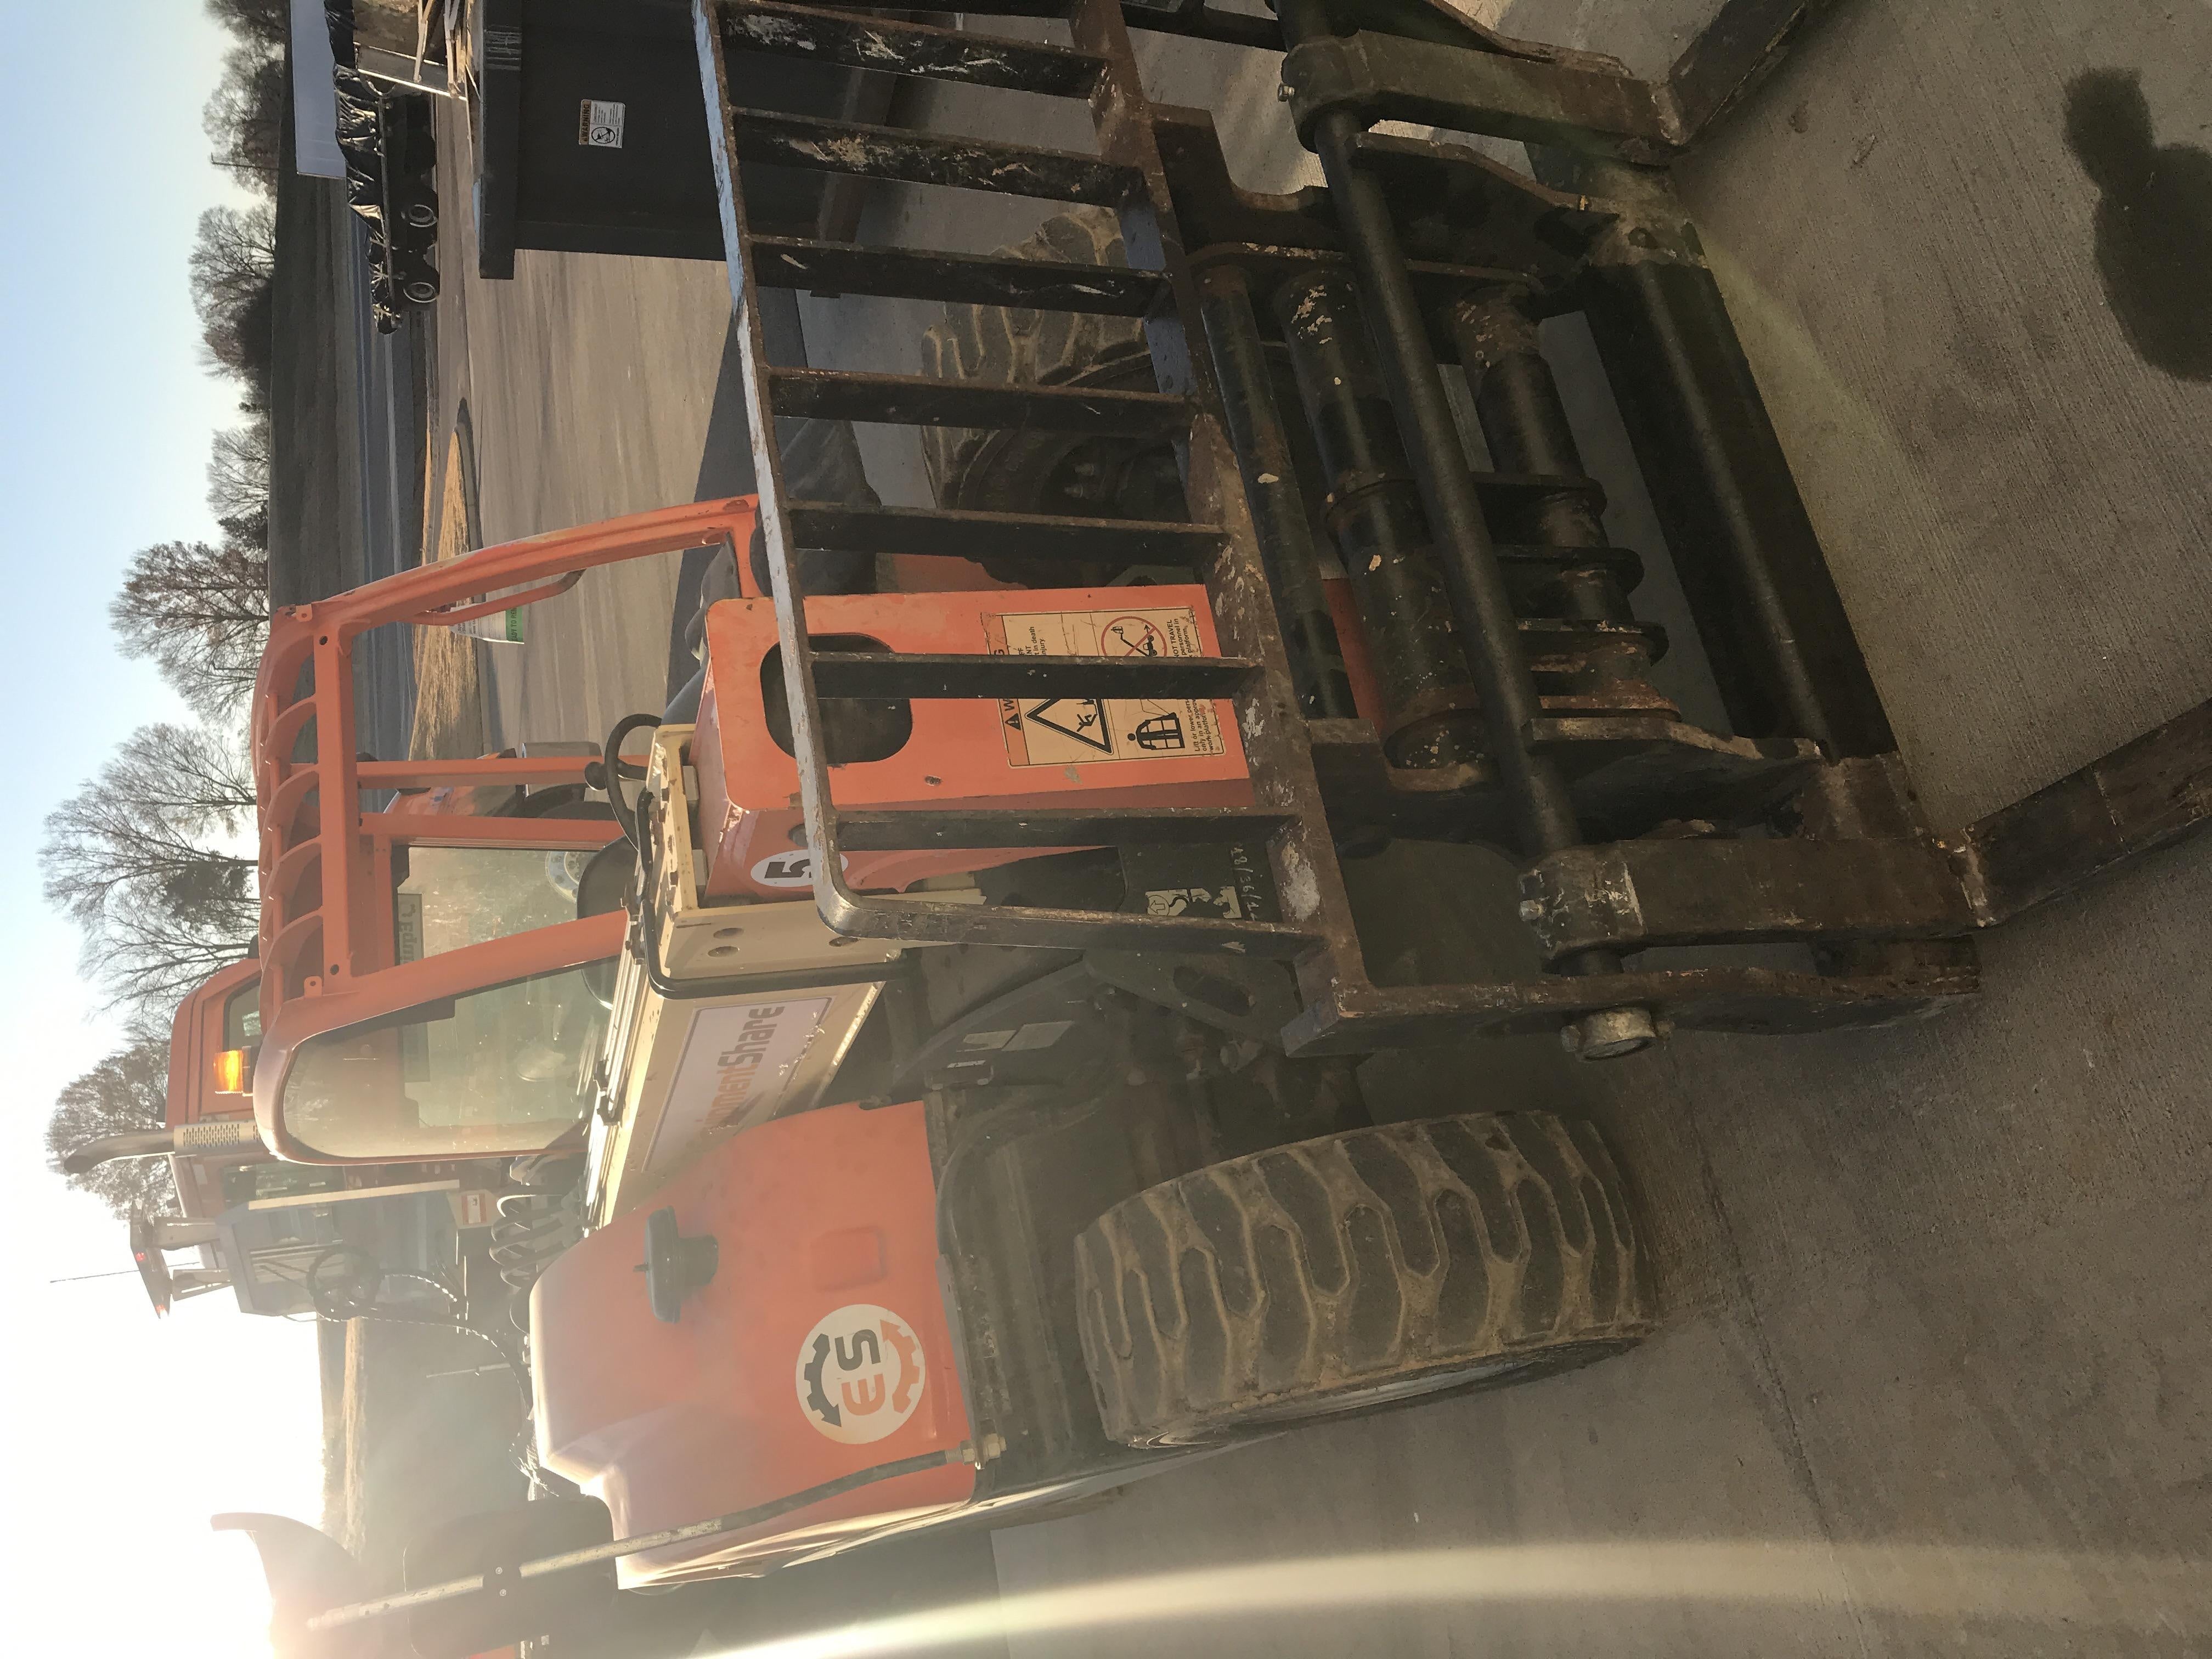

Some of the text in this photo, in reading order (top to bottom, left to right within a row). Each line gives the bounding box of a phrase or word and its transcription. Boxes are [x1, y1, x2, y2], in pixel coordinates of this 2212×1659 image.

[582, 104, 590, 138] WARNING
[1029, 627, 1037, 644] death
[1166, 619, 1176, 644] TRAVEL
[1174, 626, 1187, 656] personnel
[1192, 699, 1201, 719] approv
[1196, 721, 1202, 729] an
[1199, 738, 1207, 752] only
[1205, 735, 1214, 751] work
[834, 1329, 885, 1415] ES
